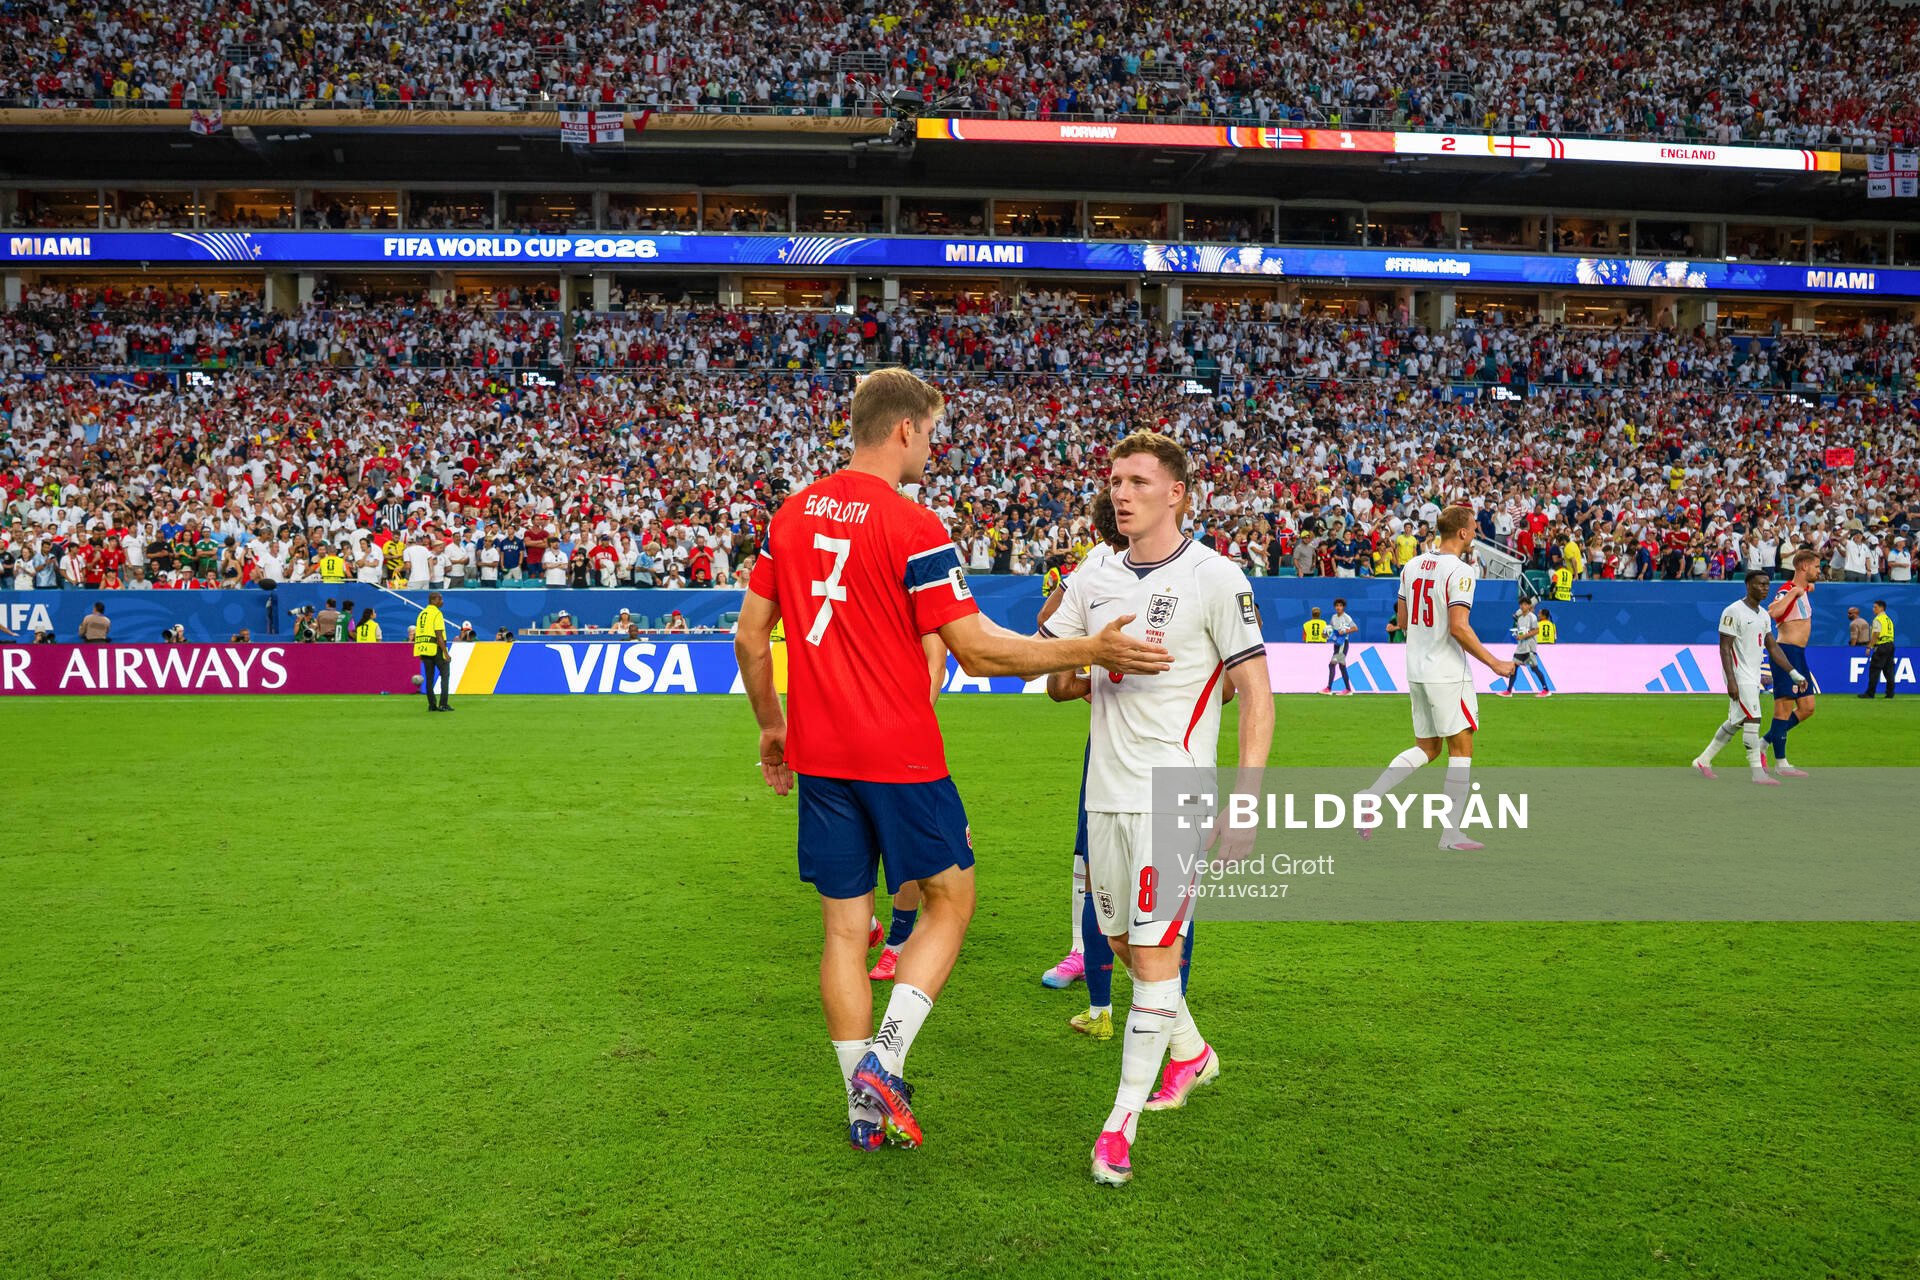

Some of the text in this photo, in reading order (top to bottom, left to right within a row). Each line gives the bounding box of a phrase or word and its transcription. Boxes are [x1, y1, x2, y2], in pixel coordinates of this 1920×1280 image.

[564, 122, 621, 131] LEEDS UNITED
[1060, 125, 1117, 138] NORWAY
[1340, 132, 1356, 148] 1
[1441, 137, 1456, 151] 2
[1660, 147, 1716, 160] ENGLAND
[10, 237, 91, 255] MIAMI
[384, 238, 657, 258] FIFA WORLD CUP 2026
[945, 244, 1024, 263] MIAMI
[1385, 257, 1470, 276] #FIFAWorldCup
[1807, 270, 1875, 289] MIAMI
[804, 494, 870, 524] SØRLOTH
[805, 533, 851, 646] 7
[1411, 577, 1435, 627] 15
[1145, 629, 1165, 637] NORWAY
[1758, 633, 1762, 647] 6
[59, 647, 288, 689] AIRWAYS
[545, 643, 698, 693] VISA
[1850, 657, 1917, 683] FA
[1138, 865, 1160, 913] 8
